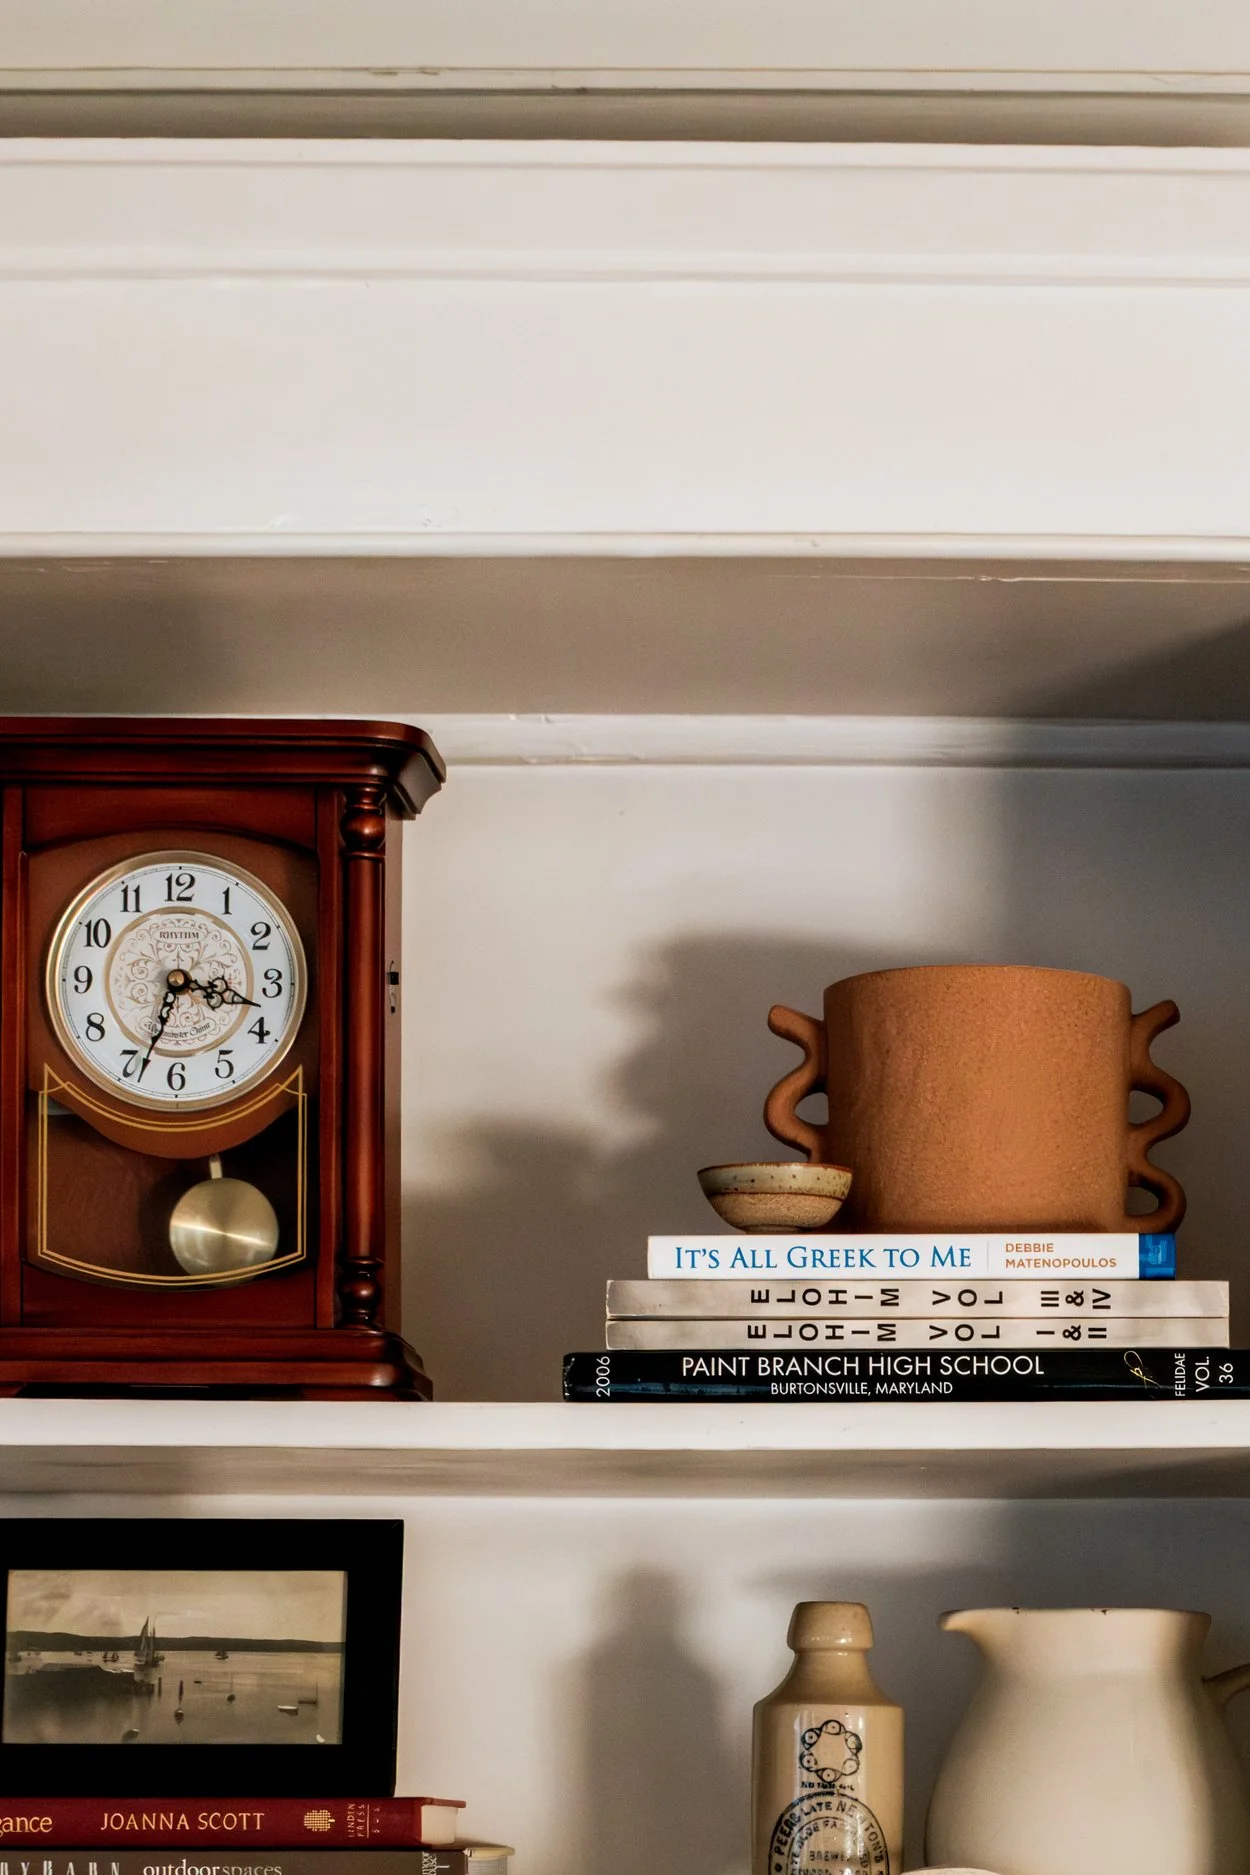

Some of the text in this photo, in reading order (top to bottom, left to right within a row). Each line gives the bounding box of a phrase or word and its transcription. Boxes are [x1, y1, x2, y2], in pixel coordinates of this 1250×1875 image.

[120, 884, 144, 913] 11
[164, 872, 196, 902] 12
[222, 886, 232, 915] 1
[83, 918, 112, 949] 10
[159, 931, 200, 940] RHYTHM
[250, 921, 272, 951] 2
[73, 965, 93, 994] 9
[261, 968, 283, 999] 3
[85, 1012, 106, 1042] 8
[247, 1016, 271, 1044] 4
[119, 1049, 139, 1079] 7
[166, 1062, 186, 1091] 6
[214, 1049, 234, 1079] 5
[730, 1247, 777, 1268] ALL
[787, 1246, 876, 1268] GREEK
[883, 1249, 919, 1267] TO
[931, 1246, 971, 1267] ME
[1006, 1243, 1053, 1252] DEBBIE
[1006, 1258, 1116, 1268] MATENOPOULOS
[751, 1288, 899, 1306] ELOHIM
[932, 1289, 1003, 1307] VOL
[748, 1323, 896, 1341] ELOHIM
[929, 1324, 1000, 1341] VOL
[596, 1356, 610, 1397] 2006
[683, 1356, 1044, 1376] PAINT BRANCH HIGH SCHOOL
[1175, 1353, 1185, 1396] FELIDAE
[1195, 1357, 1233, 1392] VOL. 36
[771, 1382, 953, 1396] BURTONSVILLE, MARYLAND
[101, 1812, 264, 1830] JOANNA SCOTT
[803, 1802, 832, 1816] LATE
[836, 1800, 884, 1865] NETON'S
